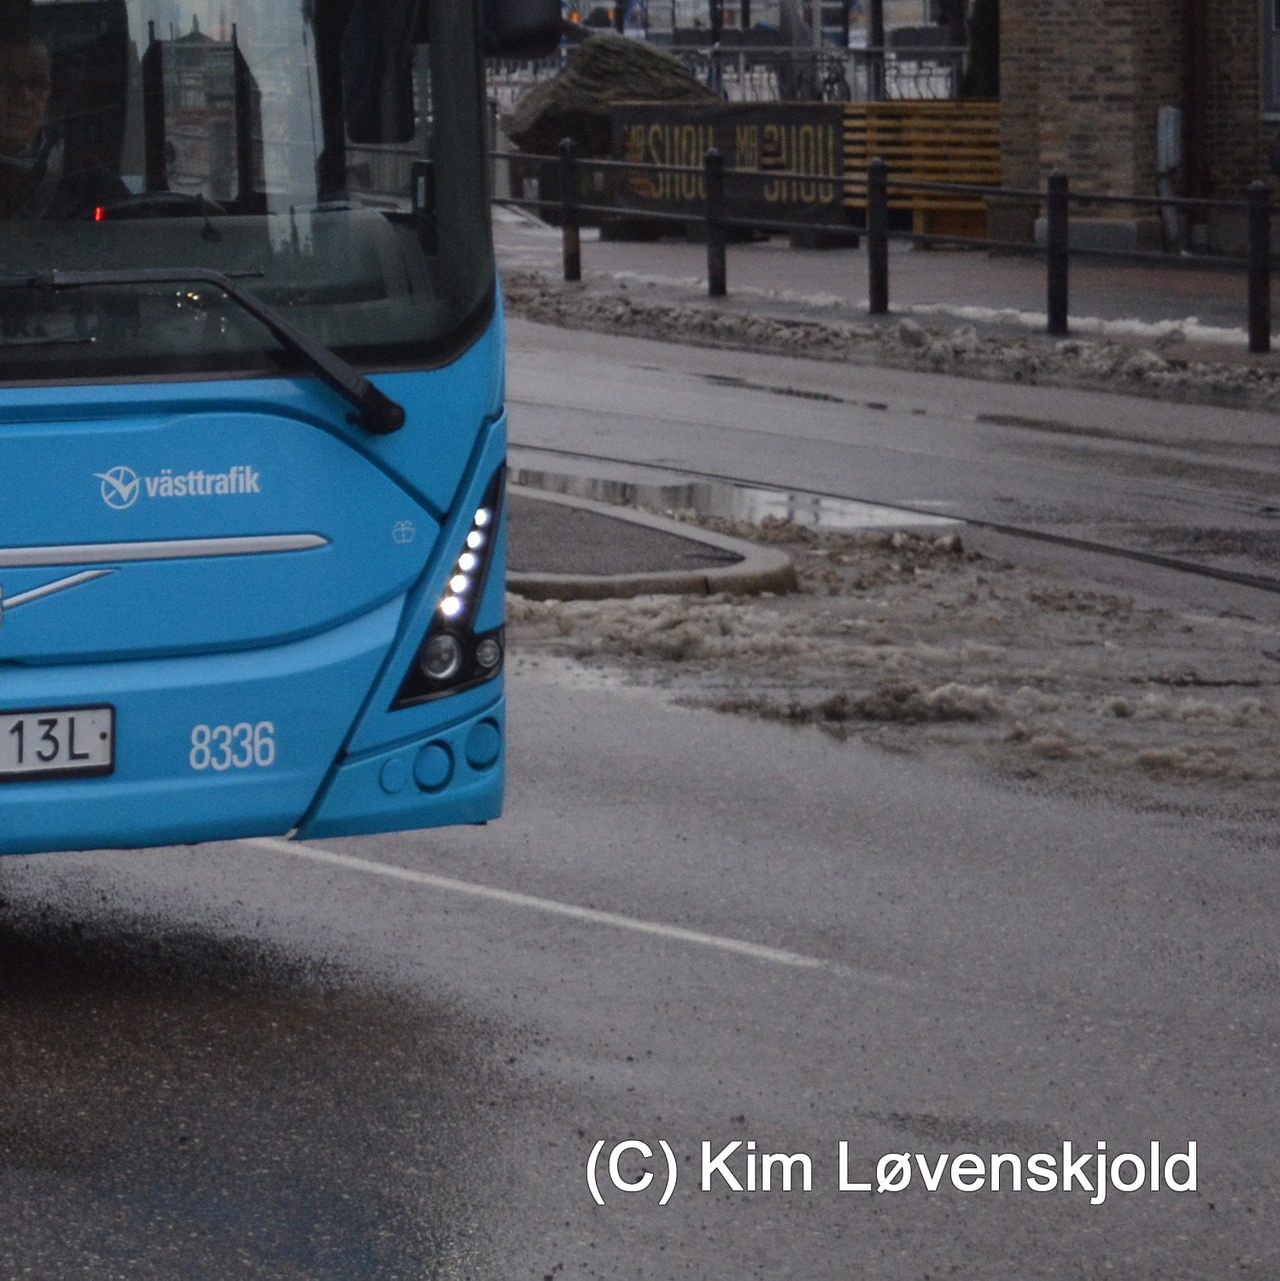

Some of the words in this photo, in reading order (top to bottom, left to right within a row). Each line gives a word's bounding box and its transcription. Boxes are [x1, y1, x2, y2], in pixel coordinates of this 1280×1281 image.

[145, 466, 260, 497] västtrafik
[9, 717, 90, 763] 13L
[189, 721, 275, 771] 8336
